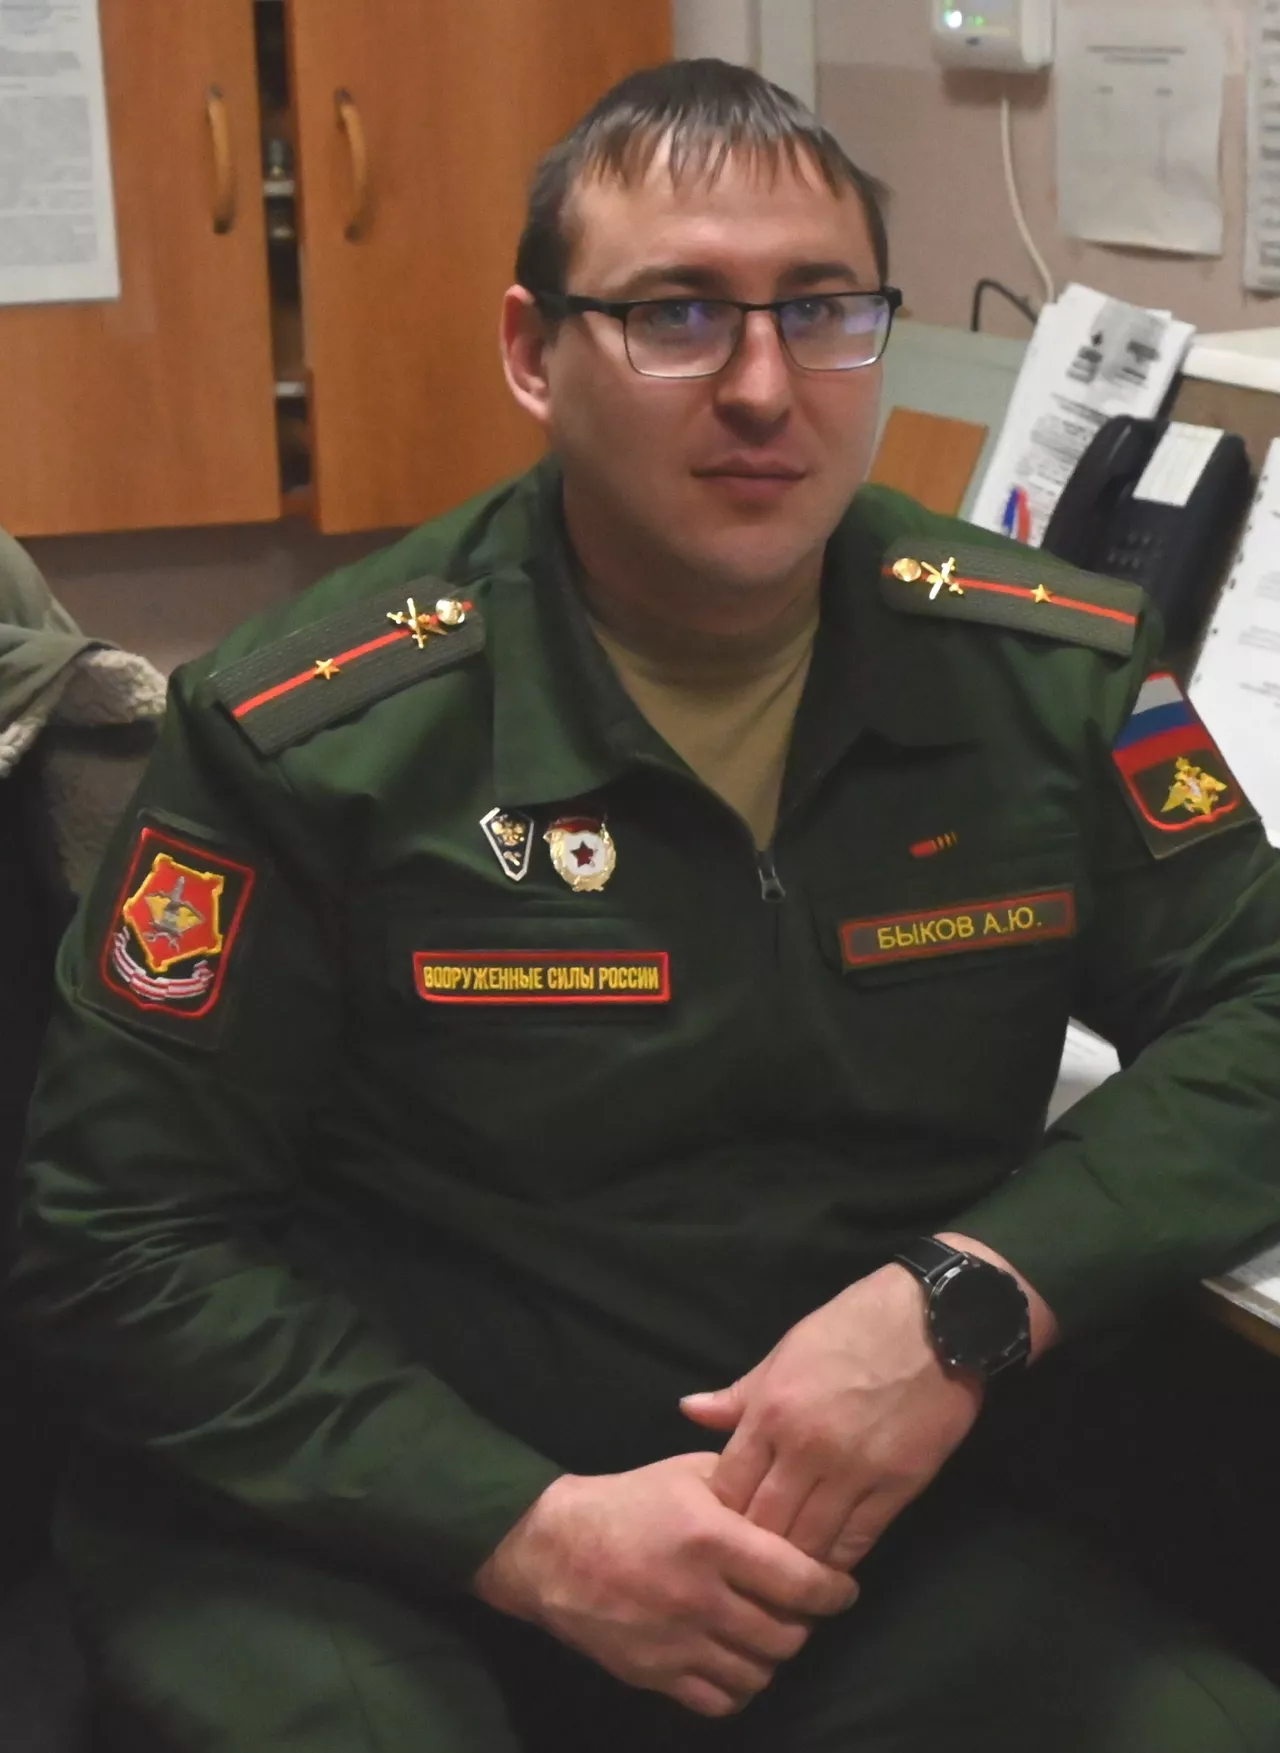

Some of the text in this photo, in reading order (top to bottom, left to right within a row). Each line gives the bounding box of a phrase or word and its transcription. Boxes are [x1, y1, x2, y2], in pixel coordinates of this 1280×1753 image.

[876, 906, 1042, 949] БЫКОВ А.Ю.
[423, 966, 659, 990] ВООРУЖЕННЫЕ СИЛЫ РОССИИ
